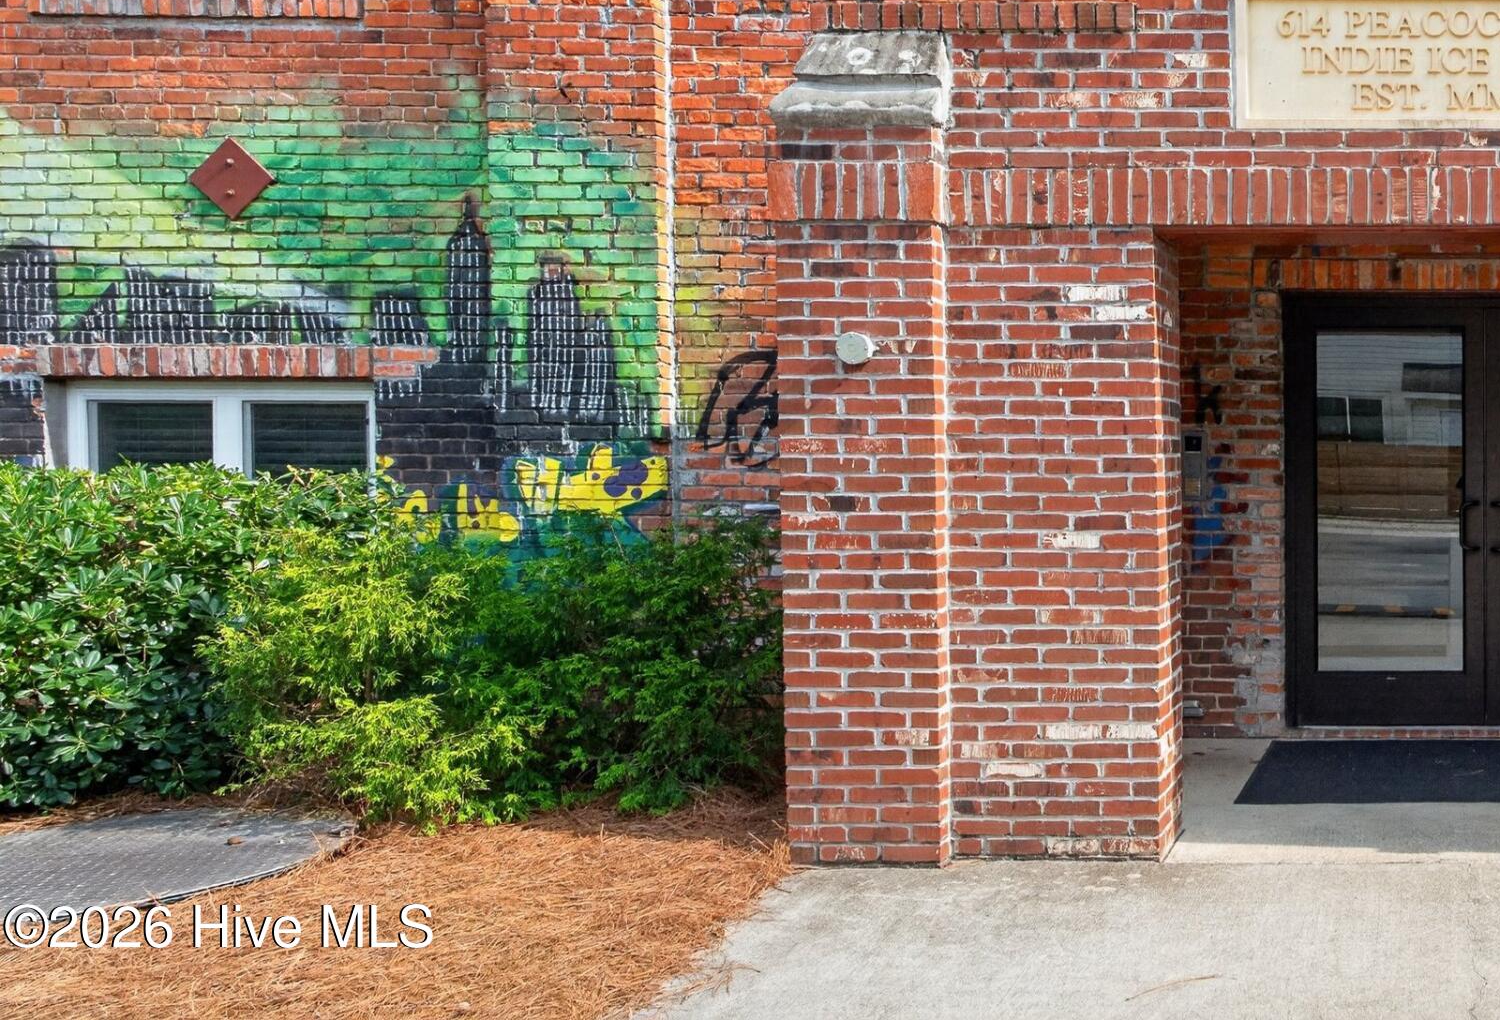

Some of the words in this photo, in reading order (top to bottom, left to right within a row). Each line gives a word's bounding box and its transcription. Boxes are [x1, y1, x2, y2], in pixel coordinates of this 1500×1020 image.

[1276, 9, 1331, 39] 614
[1301, 46, 1413, 75] INDIE
[1427, 46, 1490, 75] ICE
[1351, 83, 1429, 111] EST.
